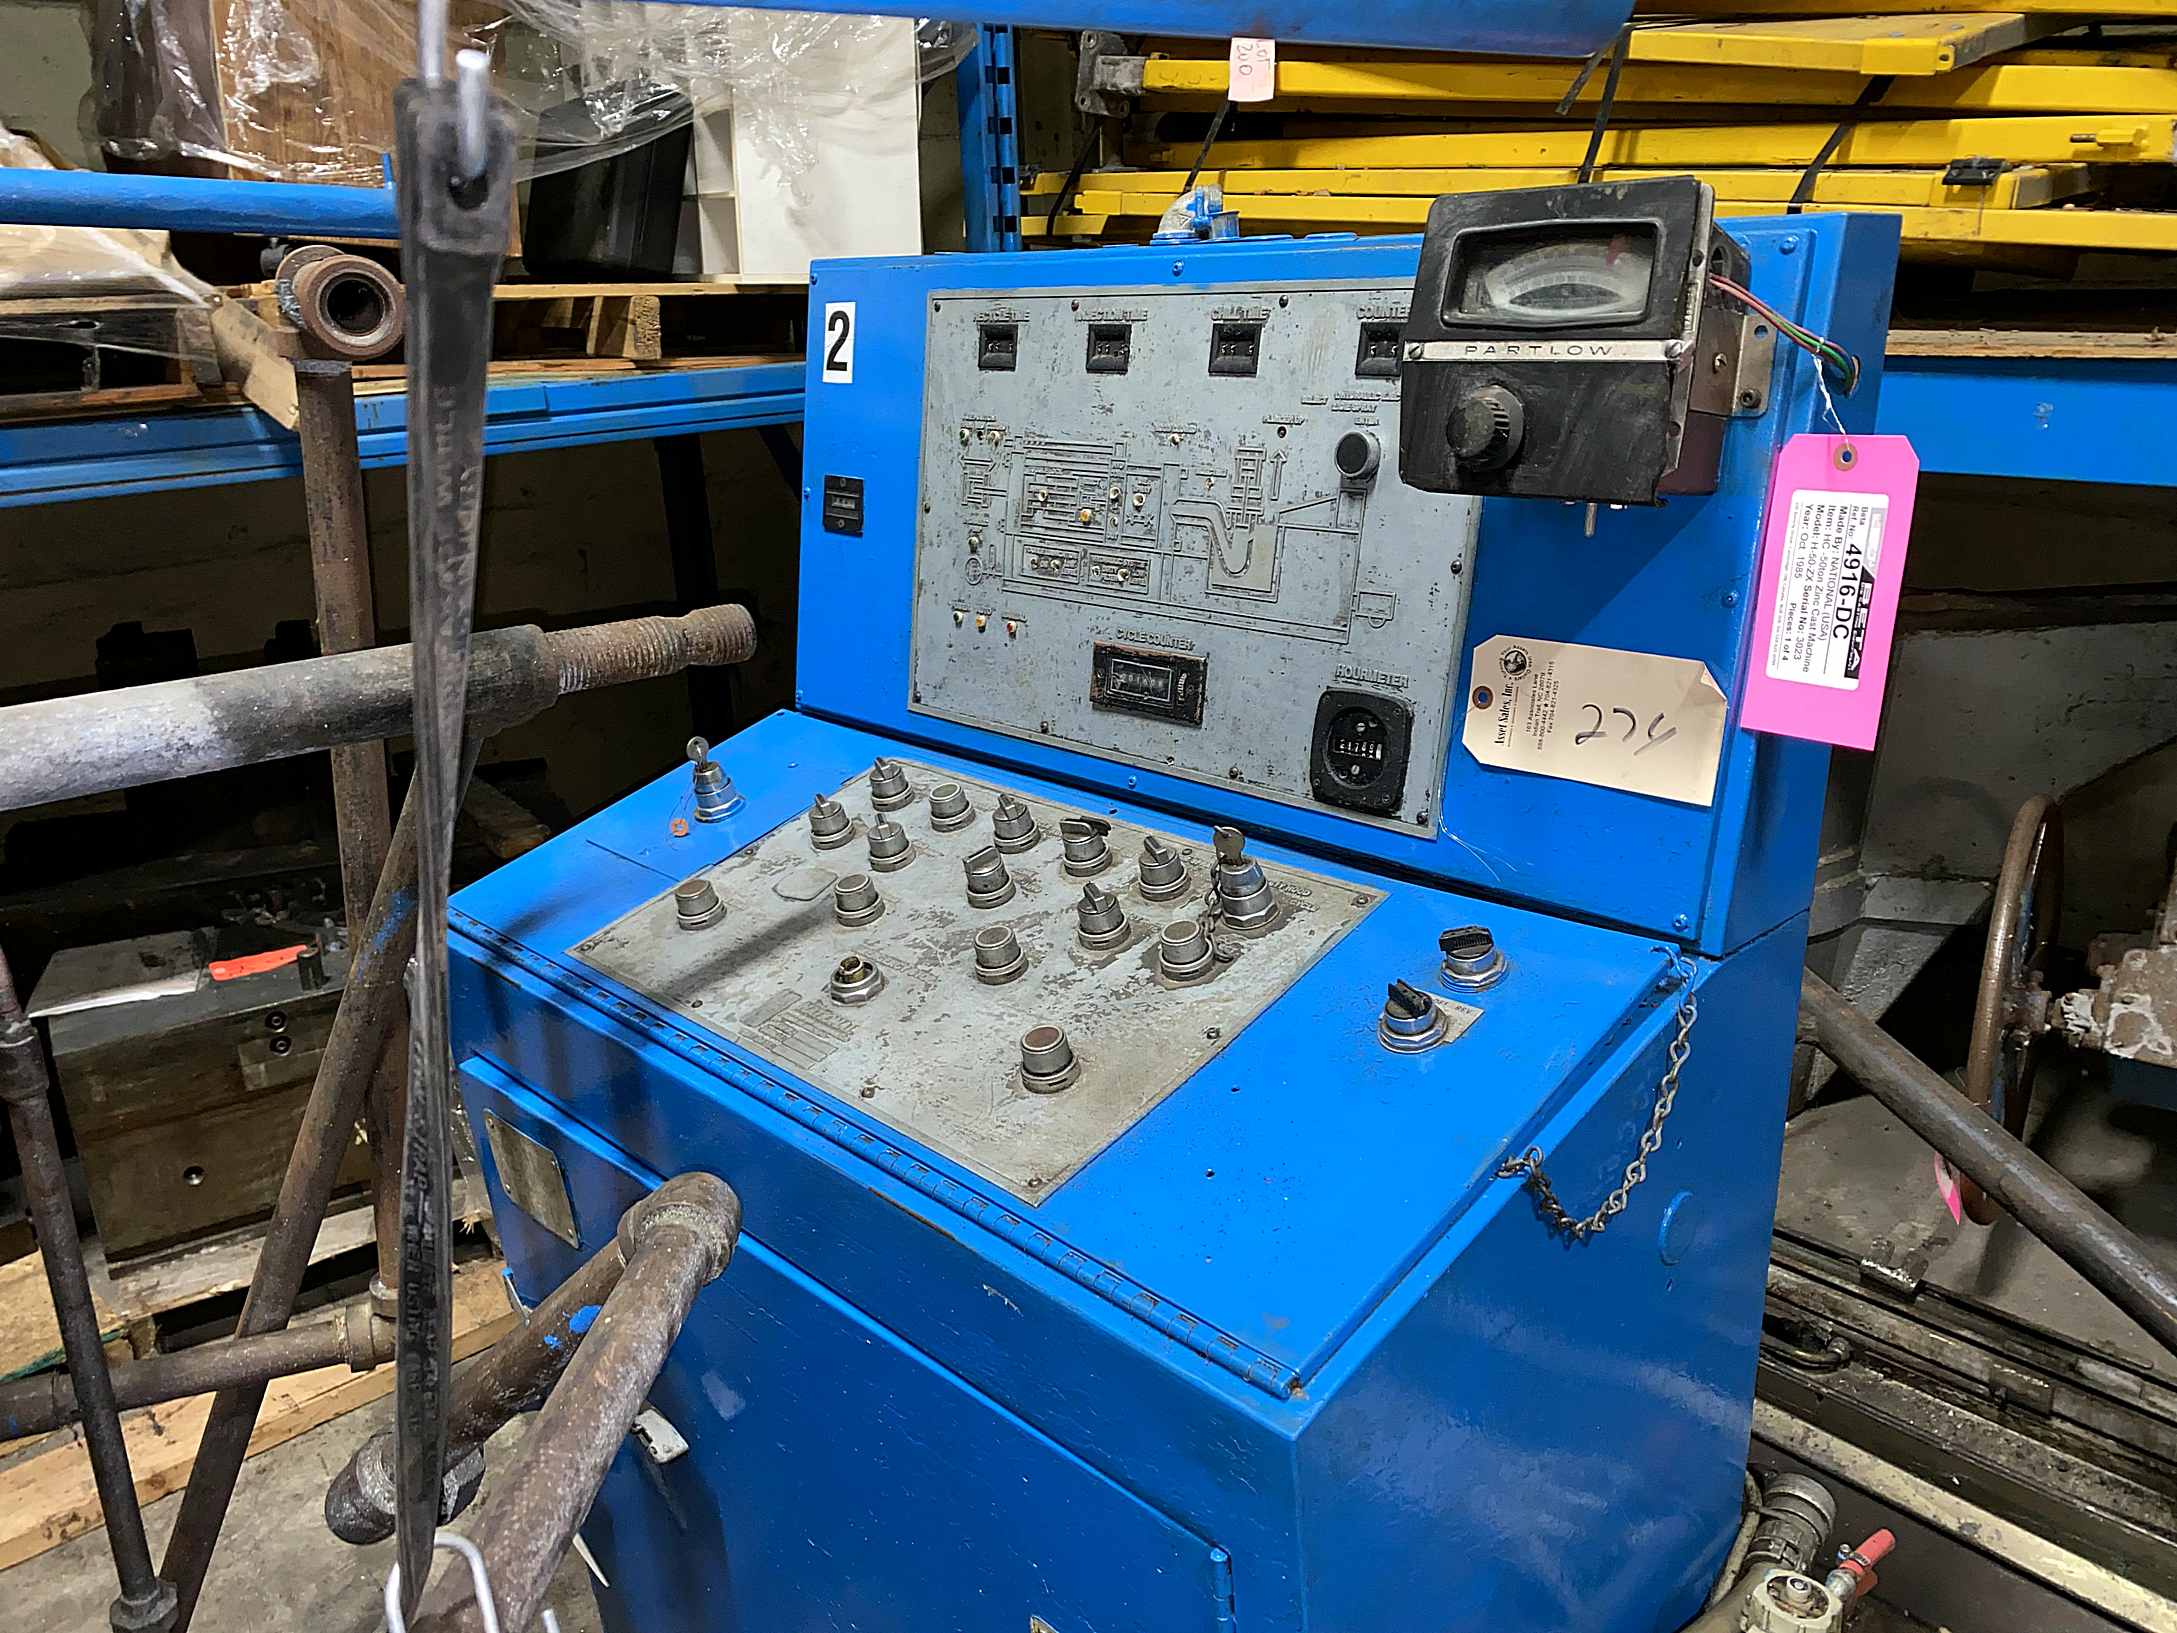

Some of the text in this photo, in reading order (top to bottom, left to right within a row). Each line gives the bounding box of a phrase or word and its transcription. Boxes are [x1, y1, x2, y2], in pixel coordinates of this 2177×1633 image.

[1356, 304, 1410, 319] COUNTE
[826, 310, 850, 371] 2
[1465, 345, 1613, 356] PARTLOW
[1801, 503, 1813, 529] Year:
[1858, 506, 1868, 525] Beta
[1793, 556, 1805, 578] 1985
[1817, 505, 1847, 640] Made By: NATIONAL (USA)
[1792, 504, 1824, 660] Model: H-50-ZX Serial No: 3023
[1802, 504, 1836, 672] Item: HC -50ton Zinc Cast Machine
[1831, 543, 1863, 640] 4916-DC
[1785, 602, 1796, 634] Pieces:
[1849, 582, 1873, 671] BETA
[1147, 631, 1194, 651] COUNTER
[1782, 643, 1790, 653] of
[1497, 698, 1511, 722] Sales,
[1493, 724, 1506, 746] Asset
